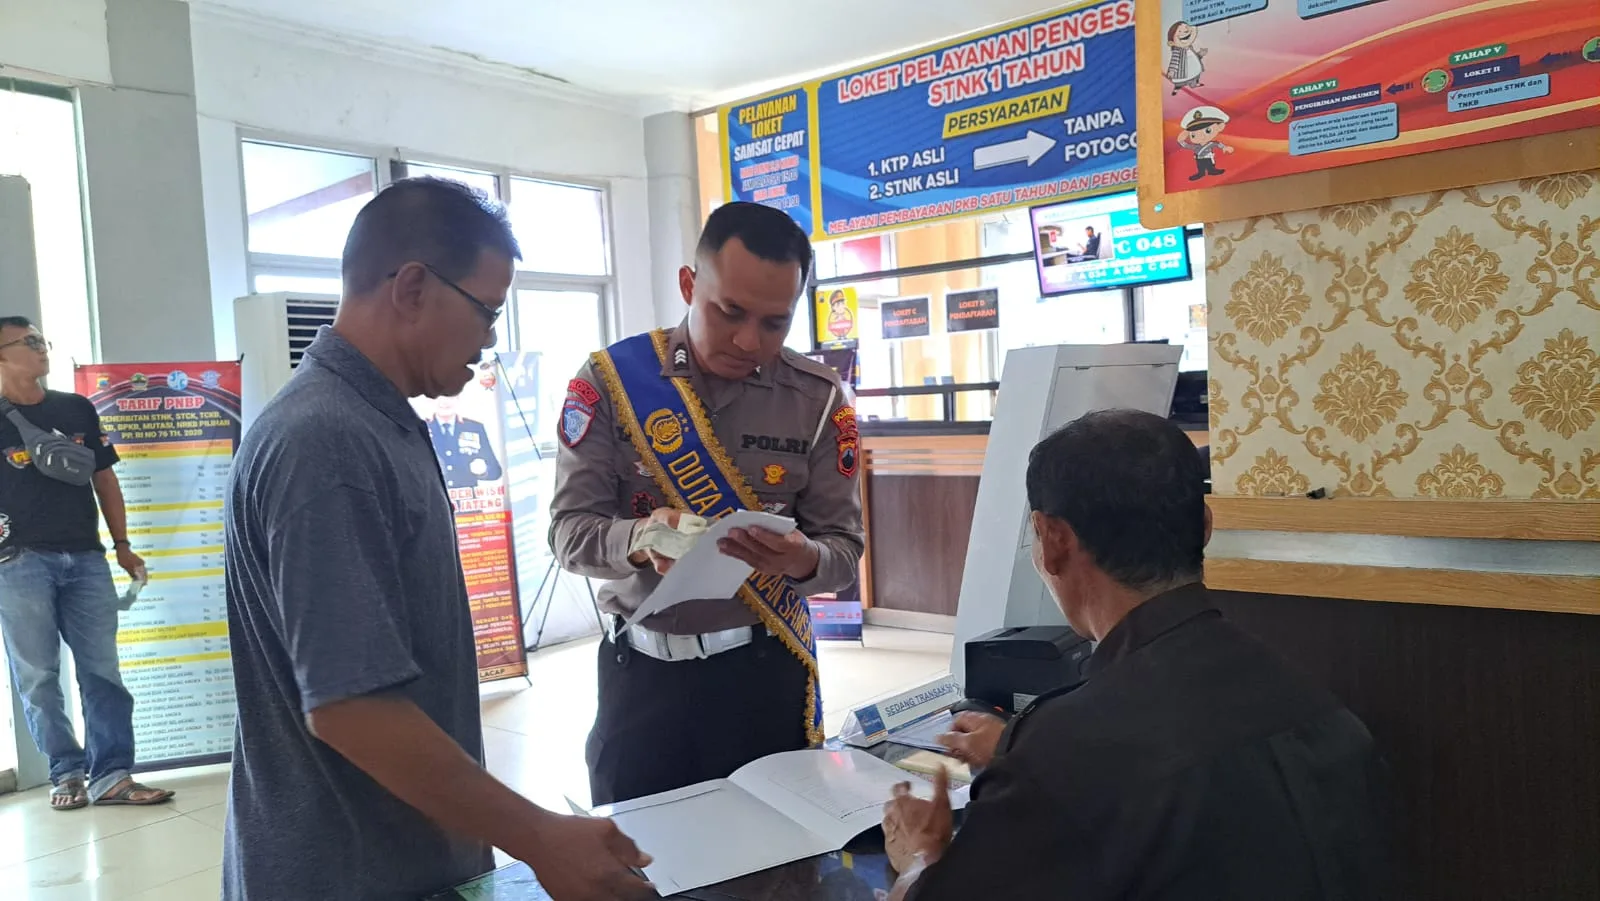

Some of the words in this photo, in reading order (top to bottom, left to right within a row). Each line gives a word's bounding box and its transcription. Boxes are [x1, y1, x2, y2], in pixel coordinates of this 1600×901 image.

[839, 66, 899, 103] LOKET
[903, 31, 1027, 86] PELAYANAN
[1033, 2, 1136, 48] PENGES
[1454, 49, 1492, 62] TAHAP
[1494, 46, 1502, 54] V
[929, 72, 986, 104] STNK
[990, 68, 1000, 89] 1
[1005, 47, 1083, 86] TAHUN
[1464, 67, 1491, 78] LOKET
[1292, 82, 1325, 96] TAHAP
[1326, 80, 1337, 88] VI
[1294, 97, 1340, 111] PENGIRIMAN
[1341, 90, 1380, 102] DOKUMEN
[1457, 86, 1503, 99] Penyerahan
[1504, 82, 1526, 92] STNK
[1527, 79, 1542, 88] dan
[739, 94, 797, 125] PELAYANAN
[948, 91, 1064, 132] PERSYARATAN
[1458, 100, 1479, 109] TNKB
[752, 116, 783, 139] LOKET
[1064, 108, 1124, 135] TANPA
[734, 138, 773, 162] SAMSAT
[774, 130, 805, 152] CEPAT
[867, 162, 878, 176] 1.
[881, 156, 909, 175] KTP
[912, 147, 945, 168] ASLI
[870, 185, 882, 200] 2.
[884, 178, 922, 197] STNK
[926, 168, 959, 189] ASLI
[828, 214, 878, 235] MELAYANI
[879, 203, 952, 226] PEMBAYARAN
[955, 196, 977, 212] PKB
[981, 192, 1011, 208] SATU
[1015, 182, 1057, 201] TAHUN
[1060, 177, 1088, 193] DAN
[1117, 240, 1131, 254] C
[1135, 233, 1177, 252] 048
[116, 397, 162, 411] TARIF
[164, 396, 206, 410] PNBP
[741, 434, 809, 455] POLRI
[668, 451, 723, 515] DUTA
[884, 696, 915, 716] SEDANG
[915, 683, 953, 705] TRANSAKSI
